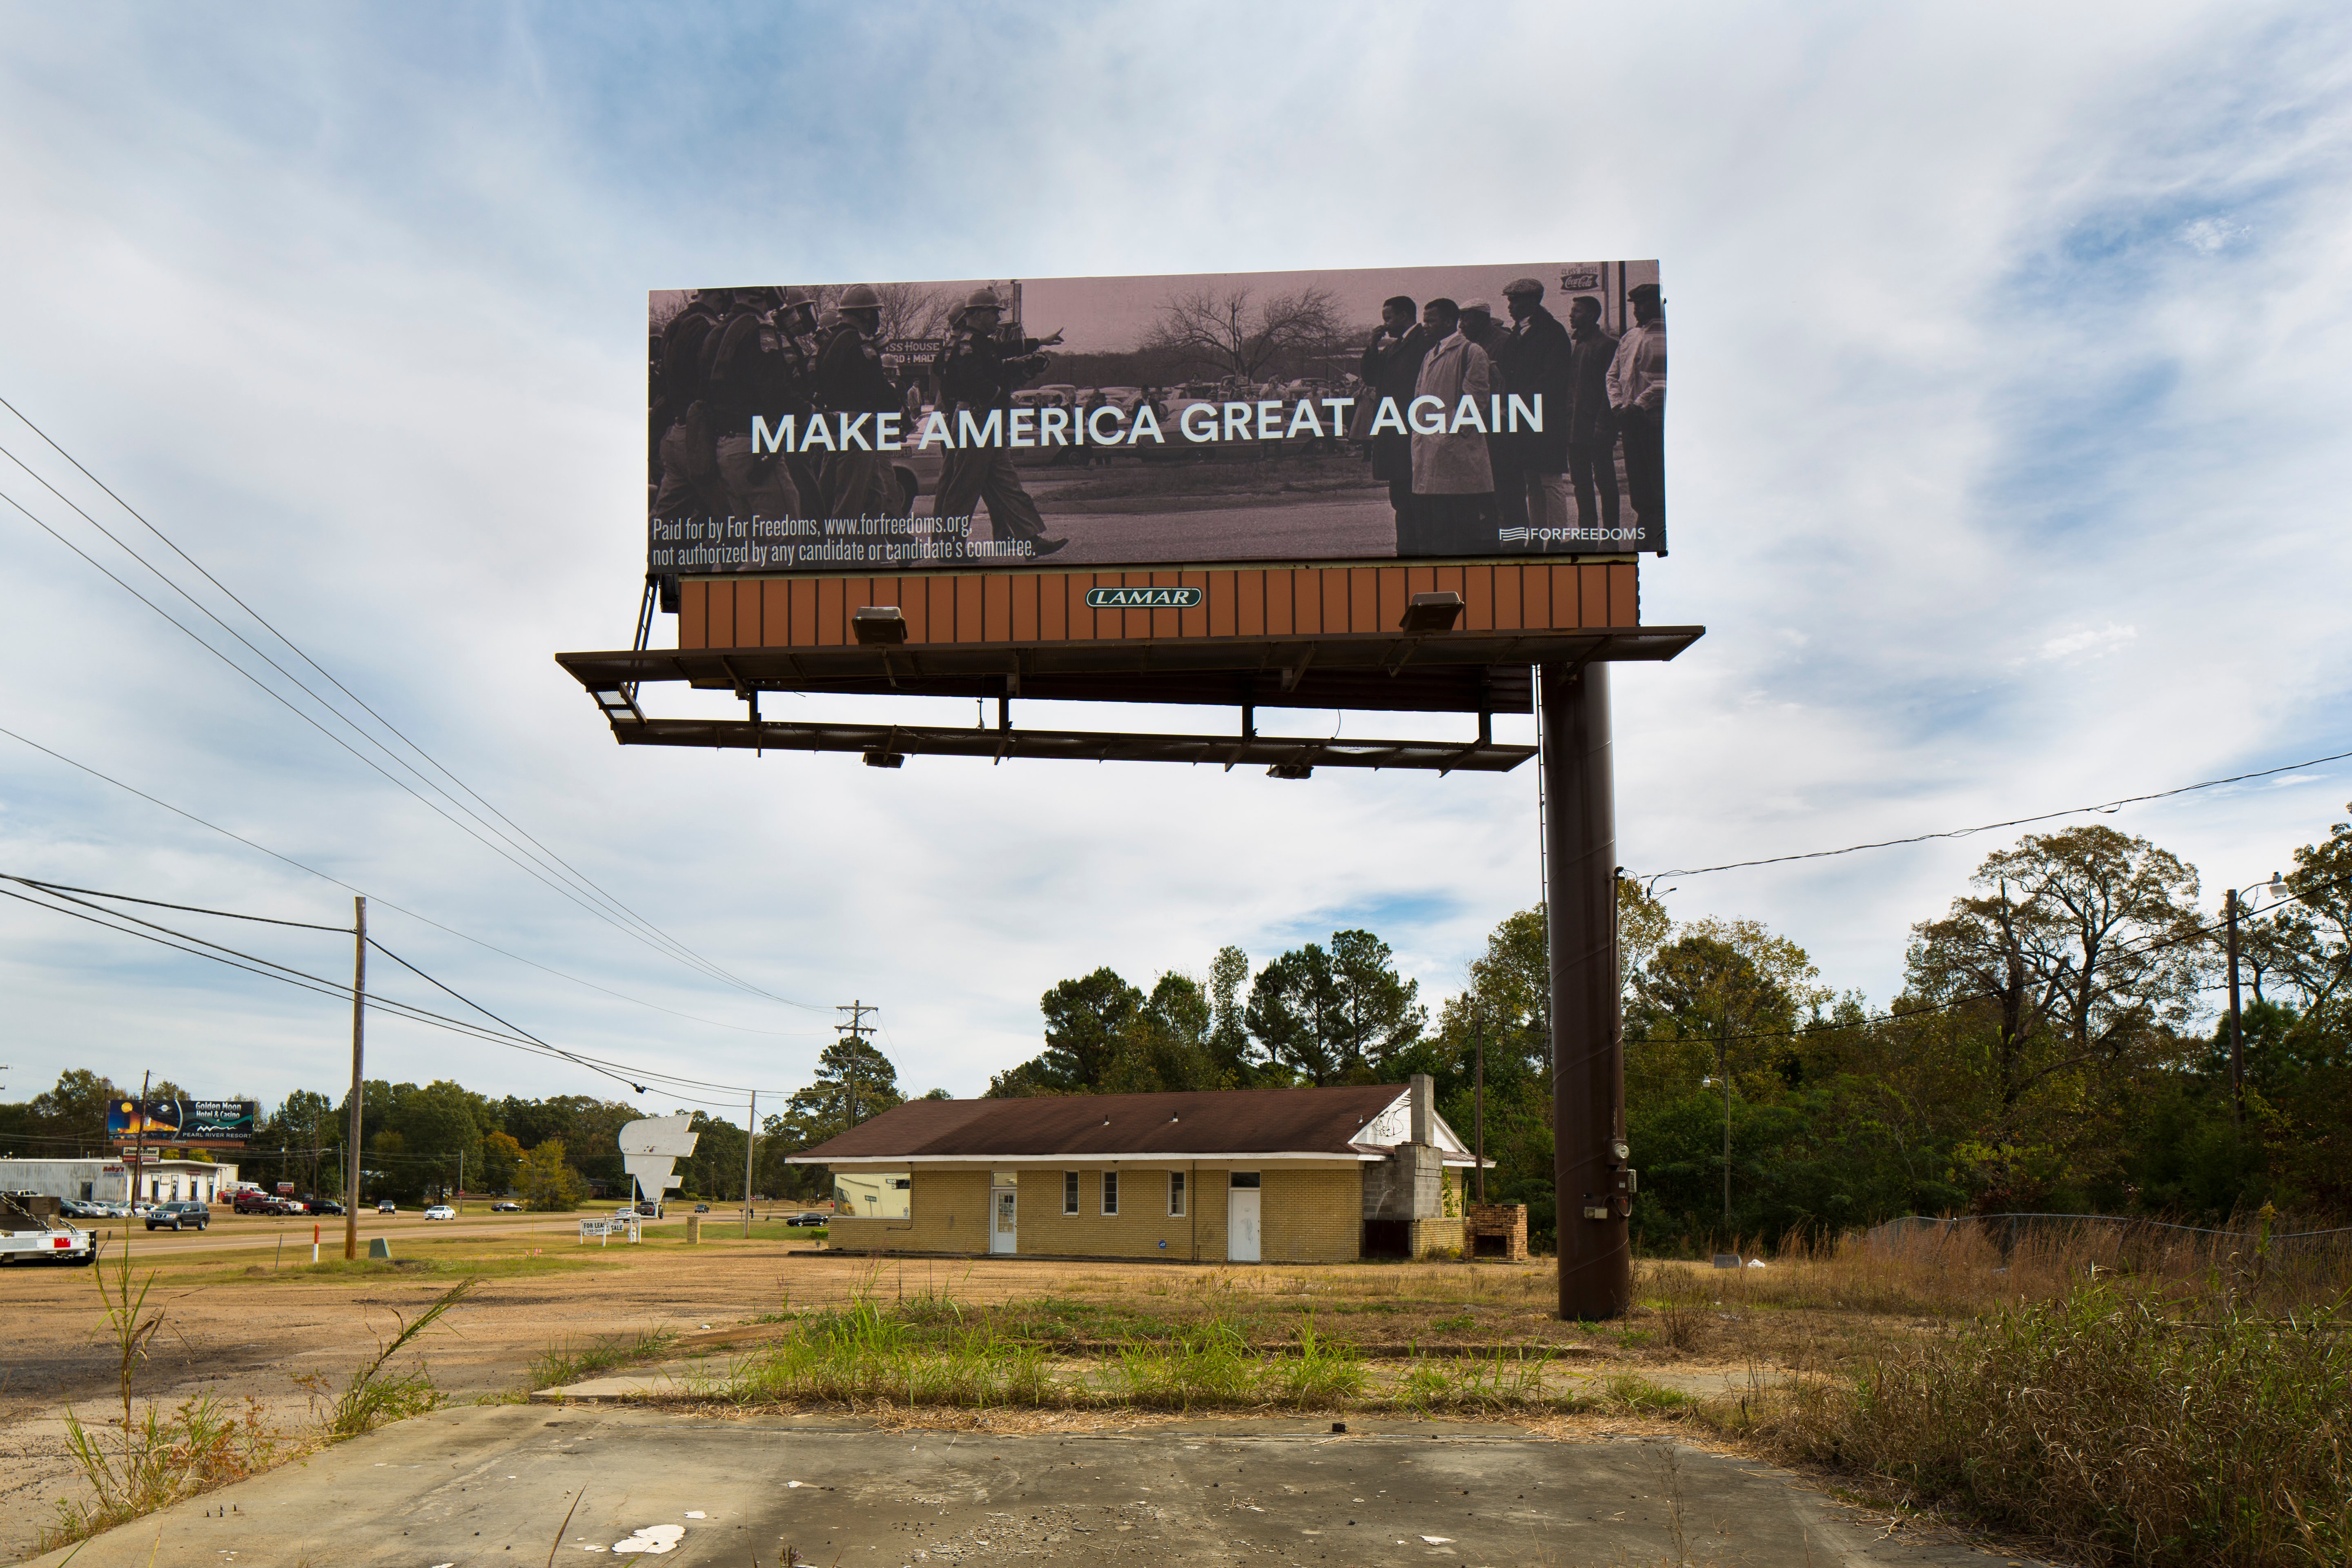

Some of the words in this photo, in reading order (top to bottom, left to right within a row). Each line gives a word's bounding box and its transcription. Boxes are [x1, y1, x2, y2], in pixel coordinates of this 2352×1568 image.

[905, 341, 939, 351] HOUSE
[752, 412, 902, 453] MAKE
[918, 405, 1165, 450] AMERICA
[1181, 398, 1354, 442] GREAT
[1370, 393, 1542, 439] AGAIN
[653, 518, 682, 540] Paid
[686, 518, 704, 539] for
[709, 517, 723, 543] by
[728, 516, 748, 537] For
[753, 514, 820, 537] Freedoms,
[824, 512, 972, 537] www.forfreedoms.org,
[1530, 528, 1646, 540] FORFREEDOMS
[653, 546, 674, 566] not
[678, 541, 748, 565] authorized
[752, 541, 767, 567] by
[771, 545, 795, 566] any
[799, 539, 864, 561] candidate
[869, 544, 882, 560] or
[886, 536, 963, 560] candidate's
[967, 536, 1036, 557] commitee.
[1096, 591, 1189, 604] LAMAR
[196, 1102, 220, 1110] Golden
[222, 1102, 241, 1111] Moon
